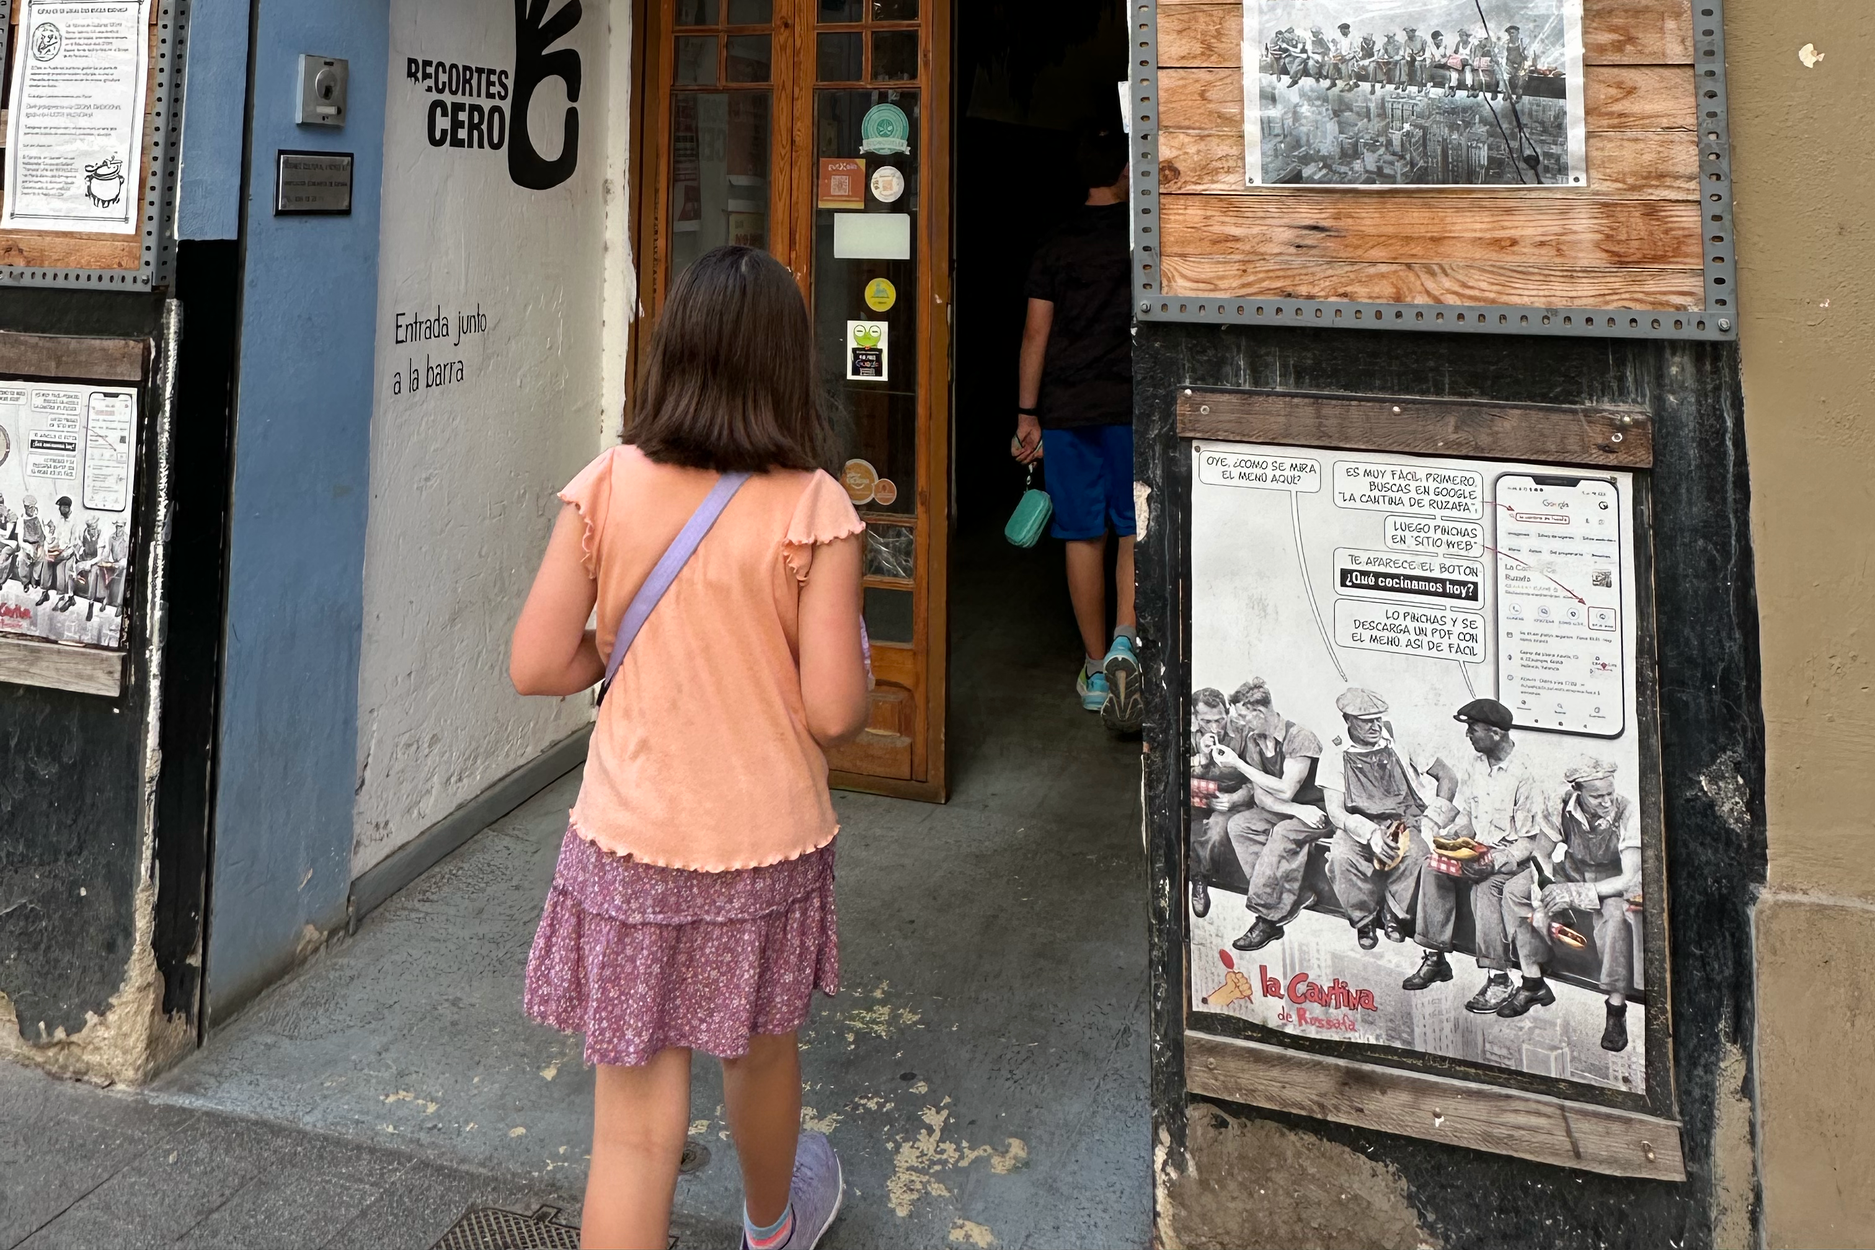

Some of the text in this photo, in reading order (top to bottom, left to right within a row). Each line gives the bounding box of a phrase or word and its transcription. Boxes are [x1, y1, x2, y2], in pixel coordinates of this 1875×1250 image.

[406, 57, 509, 101] RECORTES
[427, 99, 506, 151] CERO
[395, 302, 488, 347] Entrada junto
[393, 353, 465, 395] a la barra
[1206, 455, 1231, 468] OYE,
[1271, 460, 1287, 472] SE
[1289, 462, 1317, 475] MIRA
[1221, 470, 1235, 480] EL
[1346, 467, 1360, 478] ES
[1362, 468, 1387, 480] MUY
[1359, 492, 1406, 508] CANTINA
[1409, 497, 1426, 509] DE
[1369, 481, 1478, 501] BUSCAS EN GOOGLE
[1393, 520, 1478, 539] LUEGO PINCHAS
[1391, 534, 1407, 546] EN
[1348, 554, 1363, 566] TE
[1365, 556, 1417, 571] APARECE
[1420, 561, 1436, 573] EL
[1345, 571, 1475, 598] ¿Qué cocinamos hoy?
[1385, 609, 1479, 630] LO PINCHAS Y SE
[1353, 618, 1478, 645] DESCARGA UN PDF CON
[1351, 632, 1366, 643] EL
[1427, 641, 1444, 653] DE
[1258, 964, 1378, 1012] la Cantina
[1277, 1005, 1293, 1024] de
